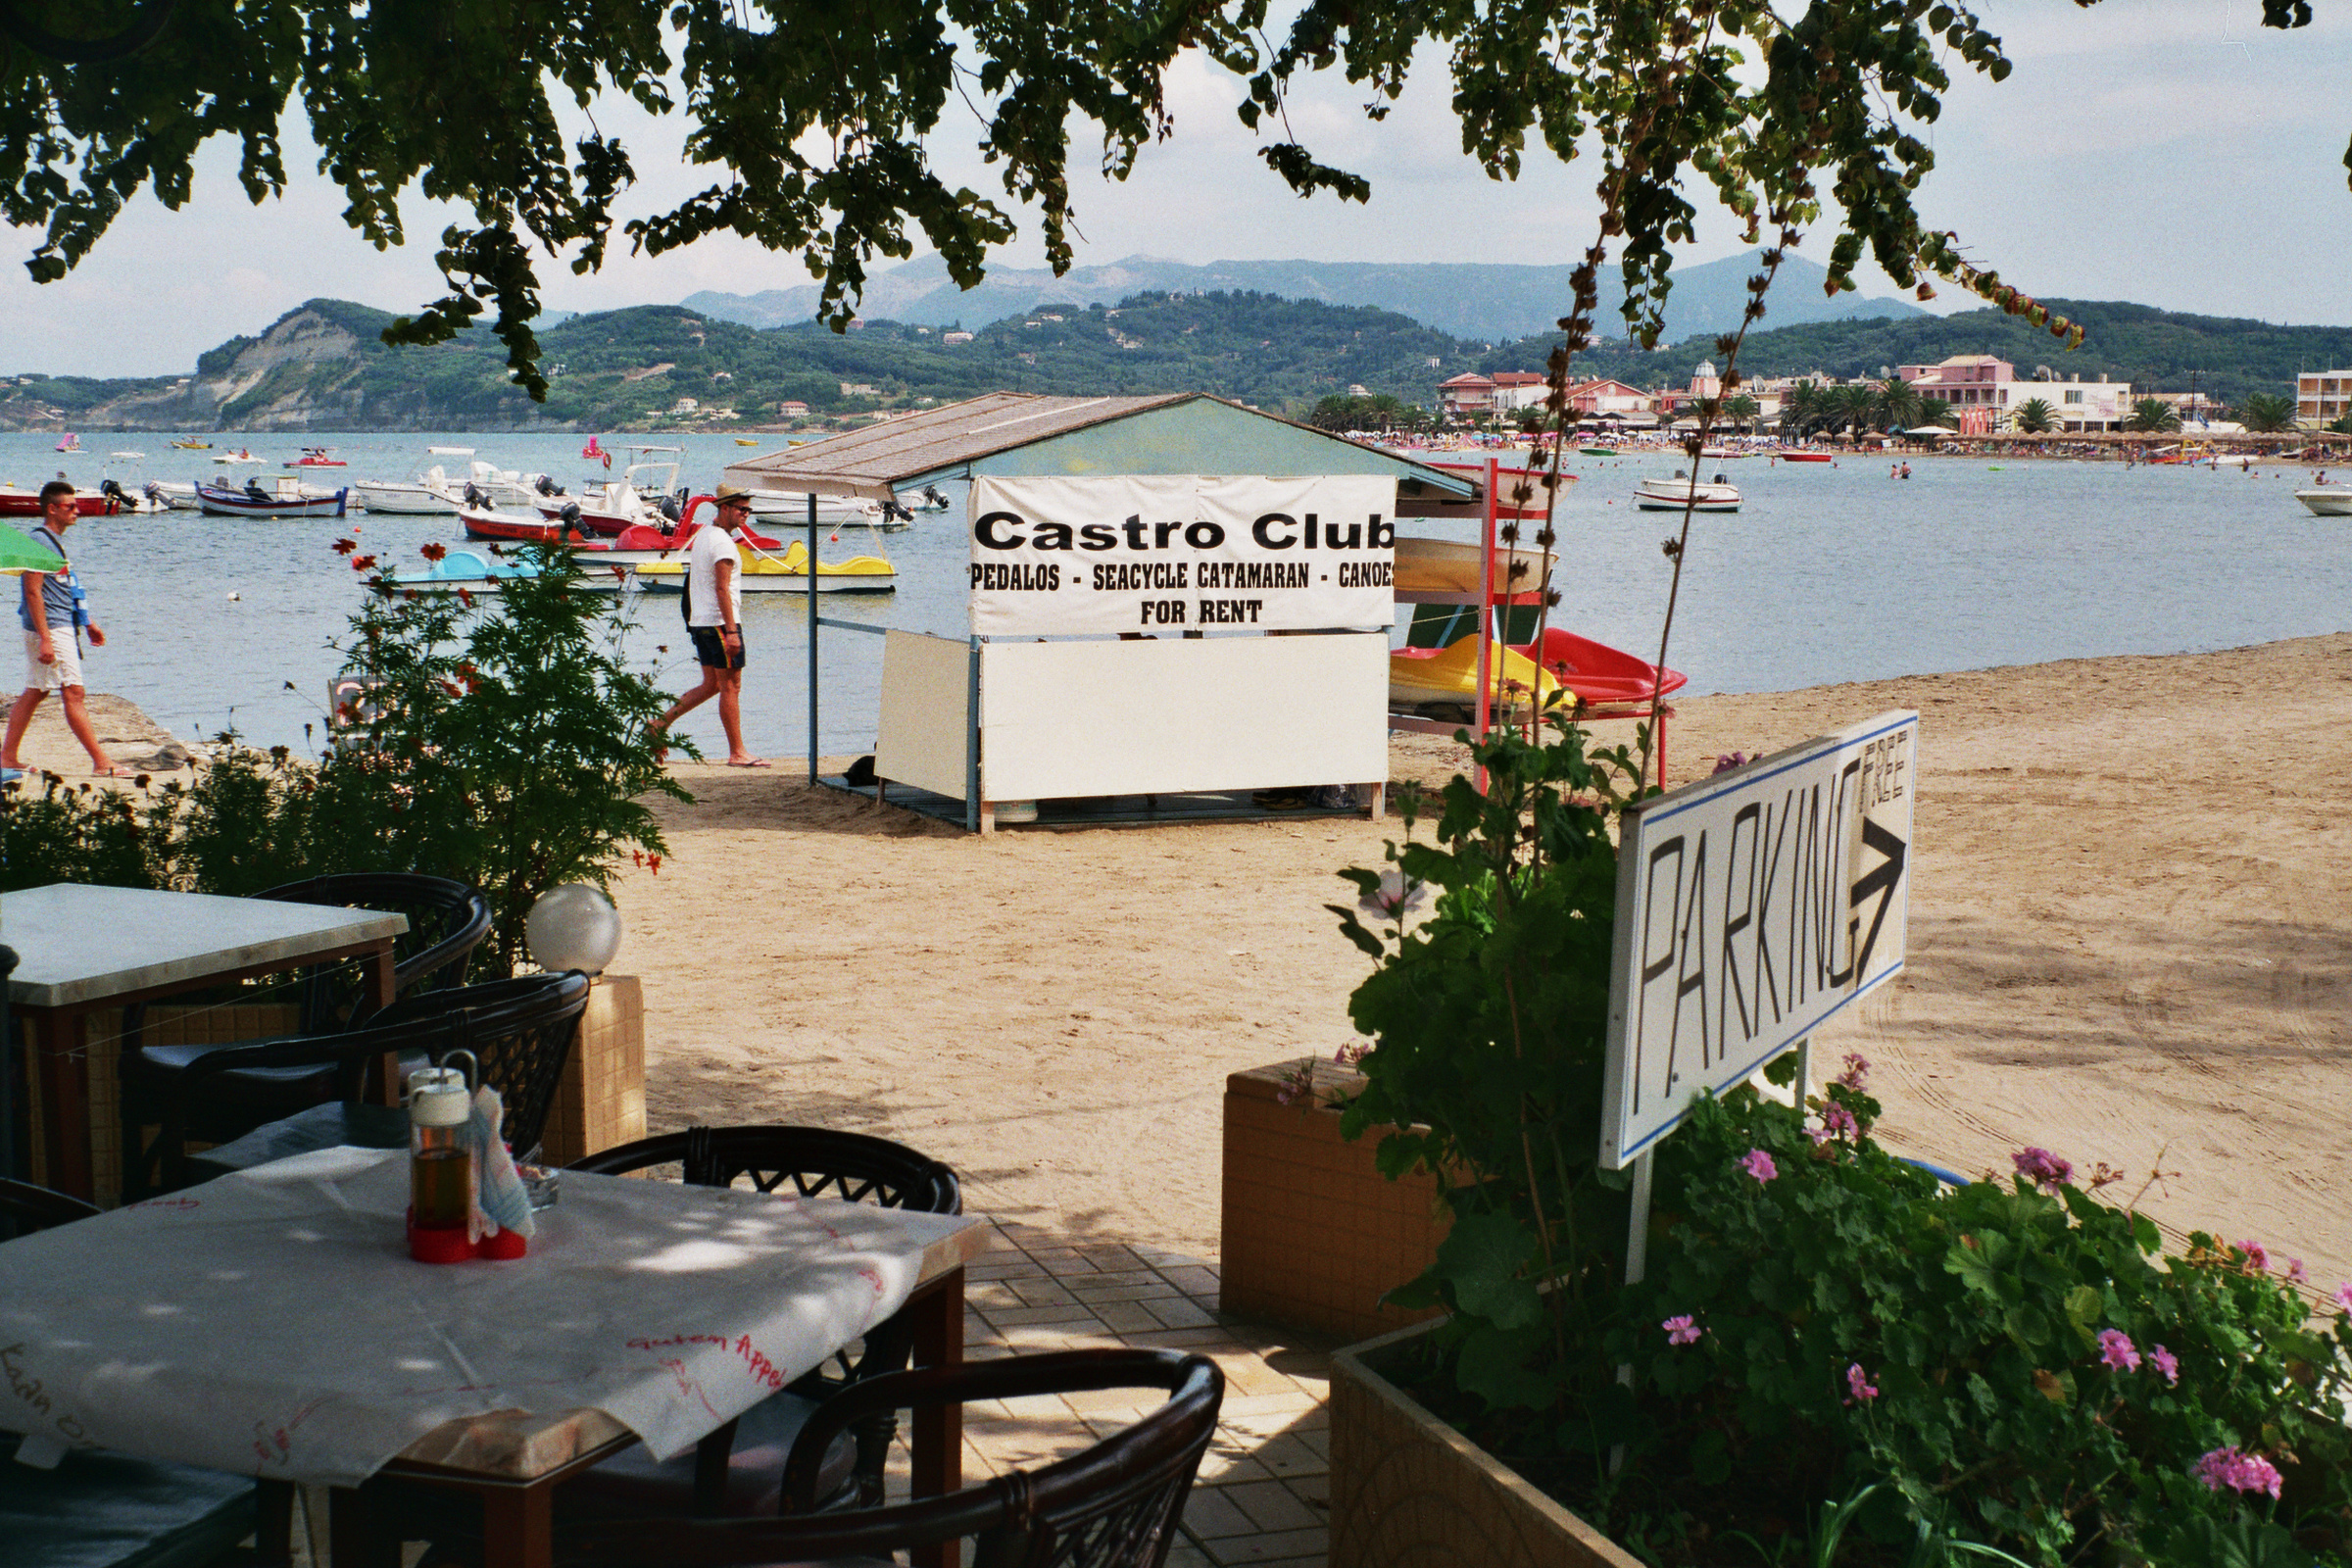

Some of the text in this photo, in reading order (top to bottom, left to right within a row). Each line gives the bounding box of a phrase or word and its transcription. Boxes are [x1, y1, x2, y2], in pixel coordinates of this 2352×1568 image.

[974, 511, 1395, 551] Castro Club
[970, 563, 1060, 591] PEDALOS
[1093, 562, 1189, 591] SEACYCLE
[1197, 562, 1310, 589] CATAMARAN
[1141, 599, 1263, 625] FOR RENT
[1860, 730, 1908, 813] FREE
[1633, 757, 1862, 1116] PARKING
